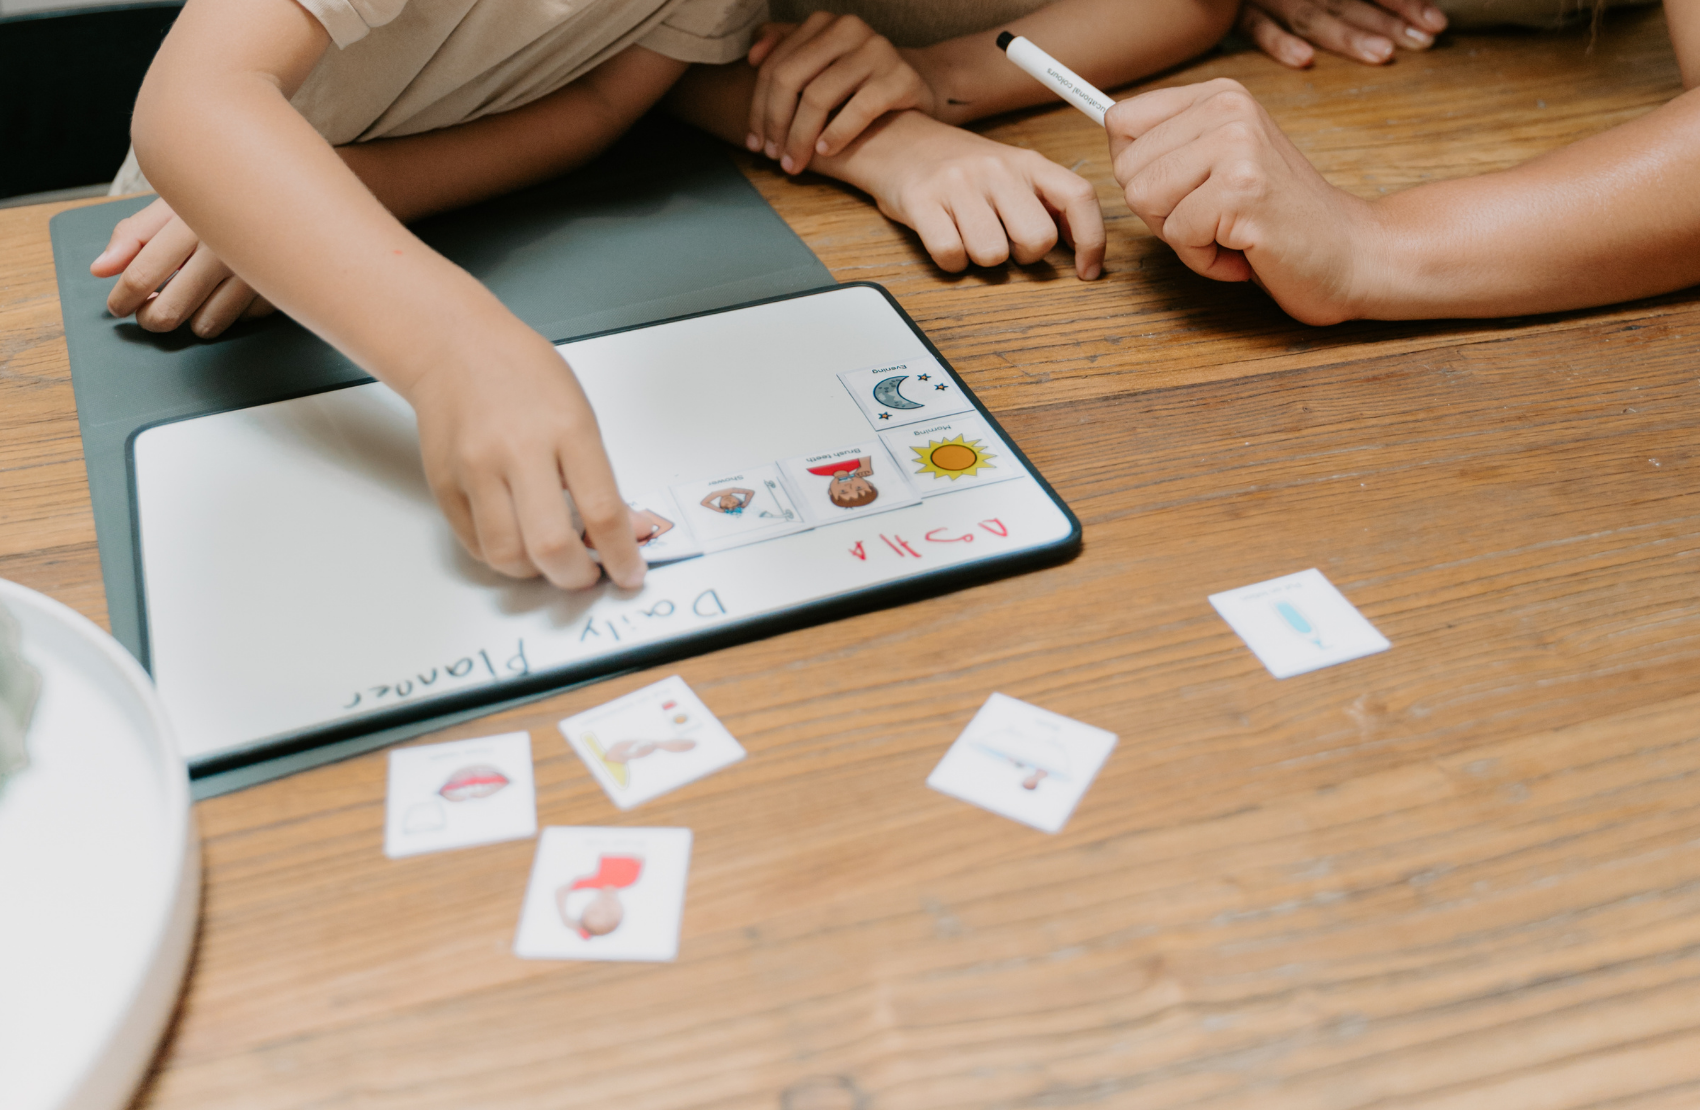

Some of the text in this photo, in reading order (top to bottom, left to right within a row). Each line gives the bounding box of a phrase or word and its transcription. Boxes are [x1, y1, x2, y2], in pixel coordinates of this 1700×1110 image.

[1047, 68, 1106, 112] ucational colours
[872, 364, 908, 374] Evening
[913, 424, 951, 436] Morning
[806, 448, 861, 463] Brush teeth
[708, 475, 744, 486] Shower
[579, 589, 728, 643] Daily
[343, 638, 535, 708] Planner
